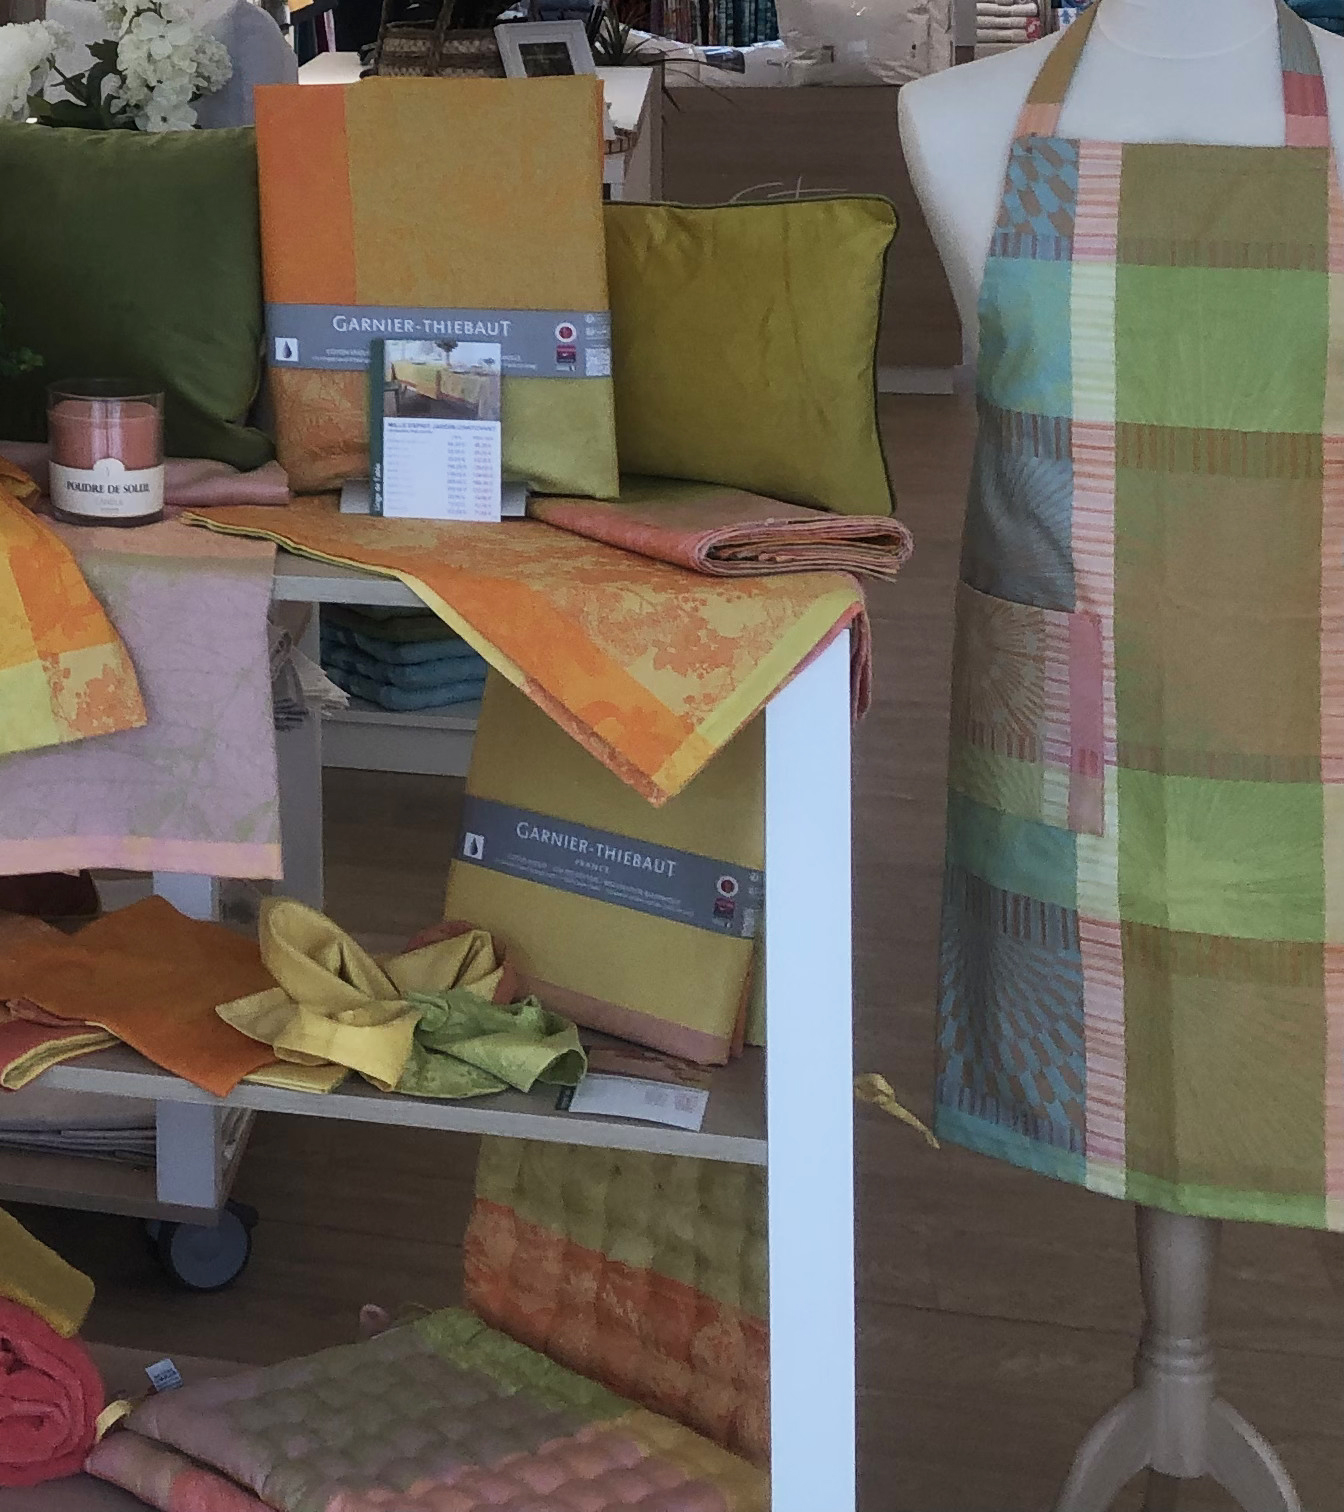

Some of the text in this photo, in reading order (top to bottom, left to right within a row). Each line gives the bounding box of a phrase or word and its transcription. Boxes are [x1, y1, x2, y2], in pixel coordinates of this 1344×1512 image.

[332, 314, 512, 337] GARNIER-THIEBAUT
[66, 481, 104, 494] POUDRE
[107, 484, 120, 494] DE
[515, 821, 677, 879] GARNIER-THIEBAUT
